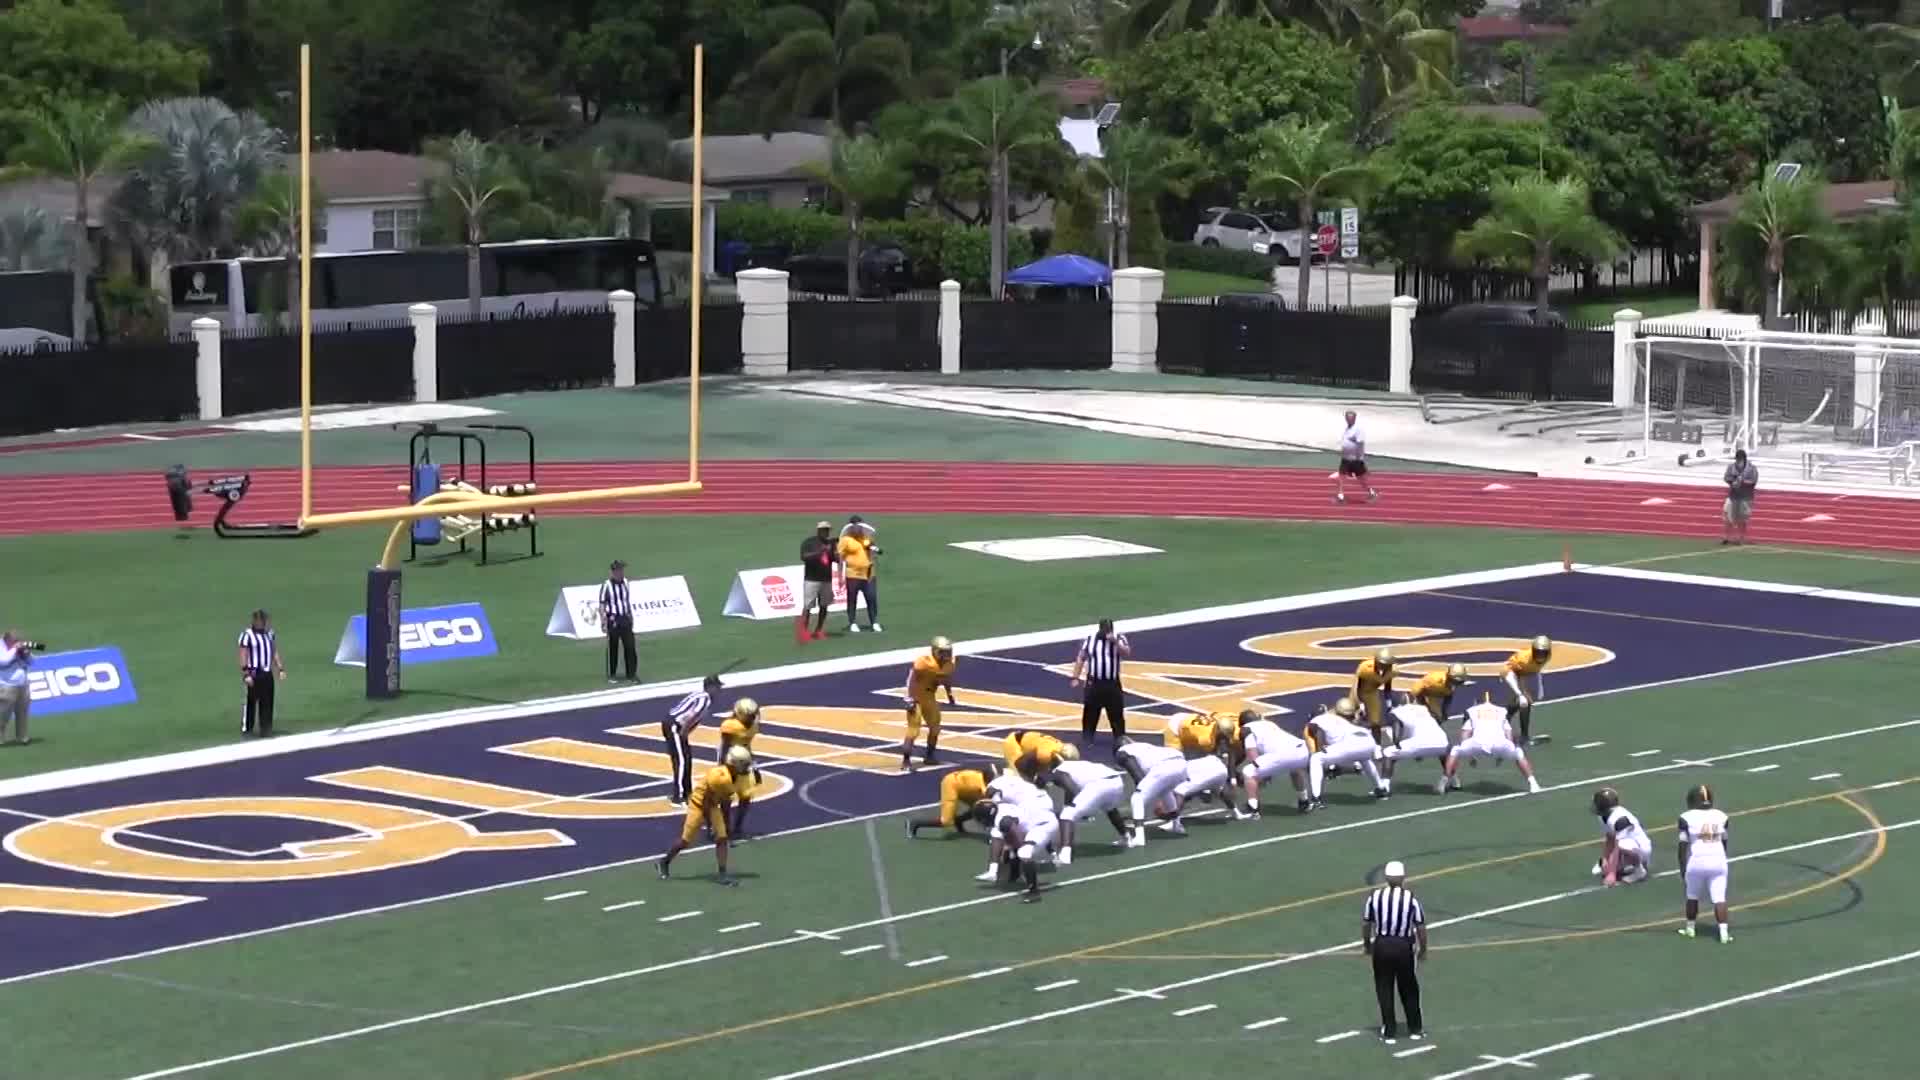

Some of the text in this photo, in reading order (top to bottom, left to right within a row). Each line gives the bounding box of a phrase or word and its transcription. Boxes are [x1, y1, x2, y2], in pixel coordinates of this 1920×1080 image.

[1319, 233, 1337, 244] STOP
[399, 617, 483, 650] EICO
[27, 662, 121, 700] EICO
